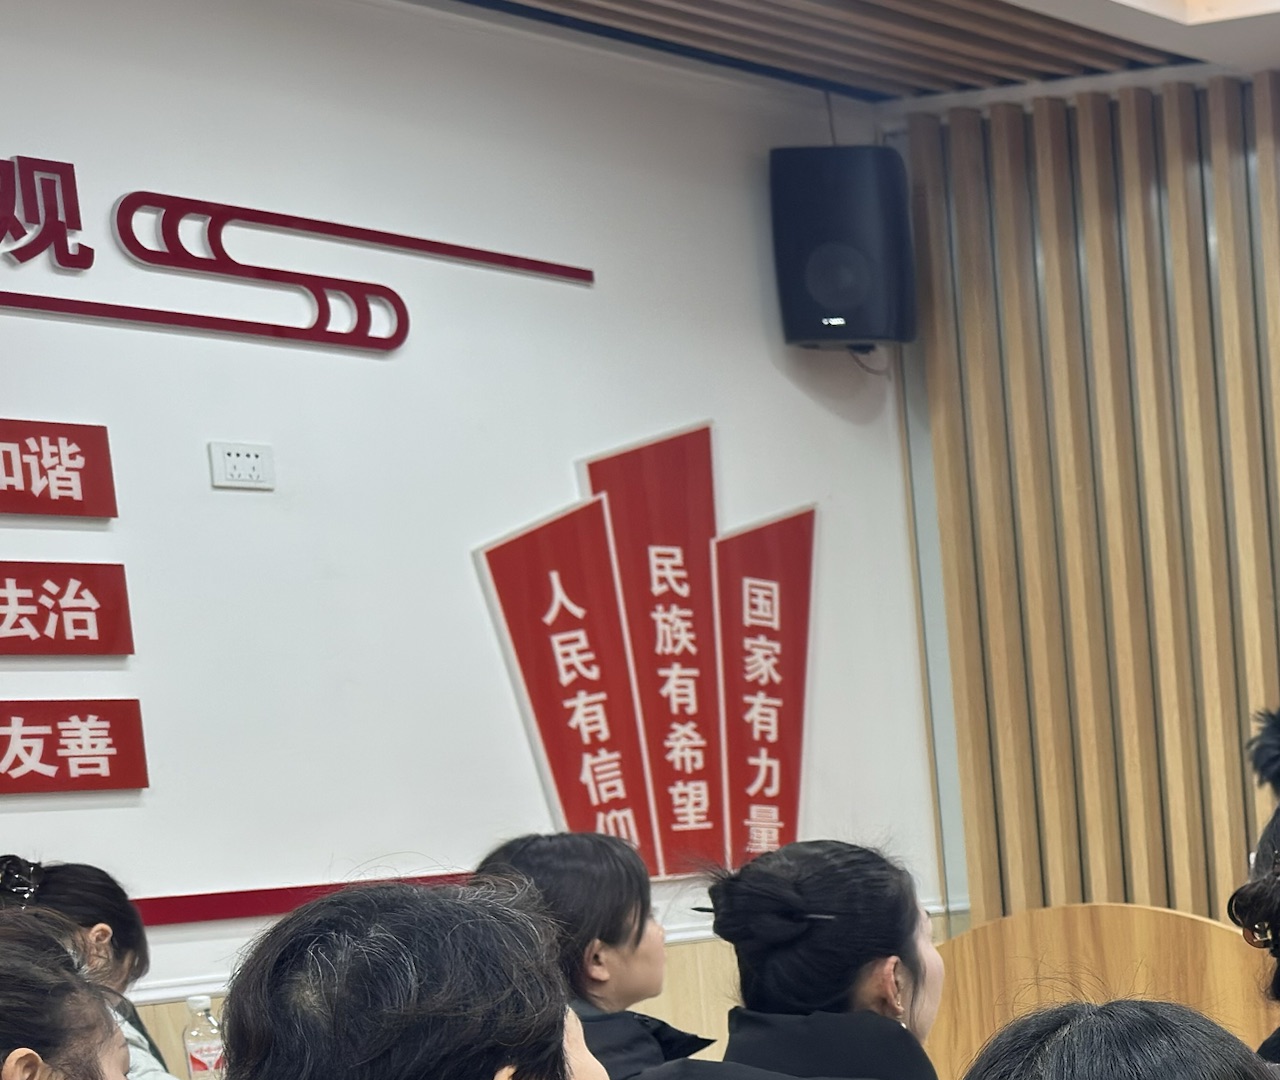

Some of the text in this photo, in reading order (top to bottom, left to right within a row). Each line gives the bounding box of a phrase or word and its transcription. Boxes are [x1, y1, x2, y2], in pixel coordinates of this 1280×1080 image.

[0, 156, 94, 269] 观
[0, 715, 117, 778] 友善
[648, 545, 713, 832] 民族有希望
[742, 577, 784, 853] 国家有力量
